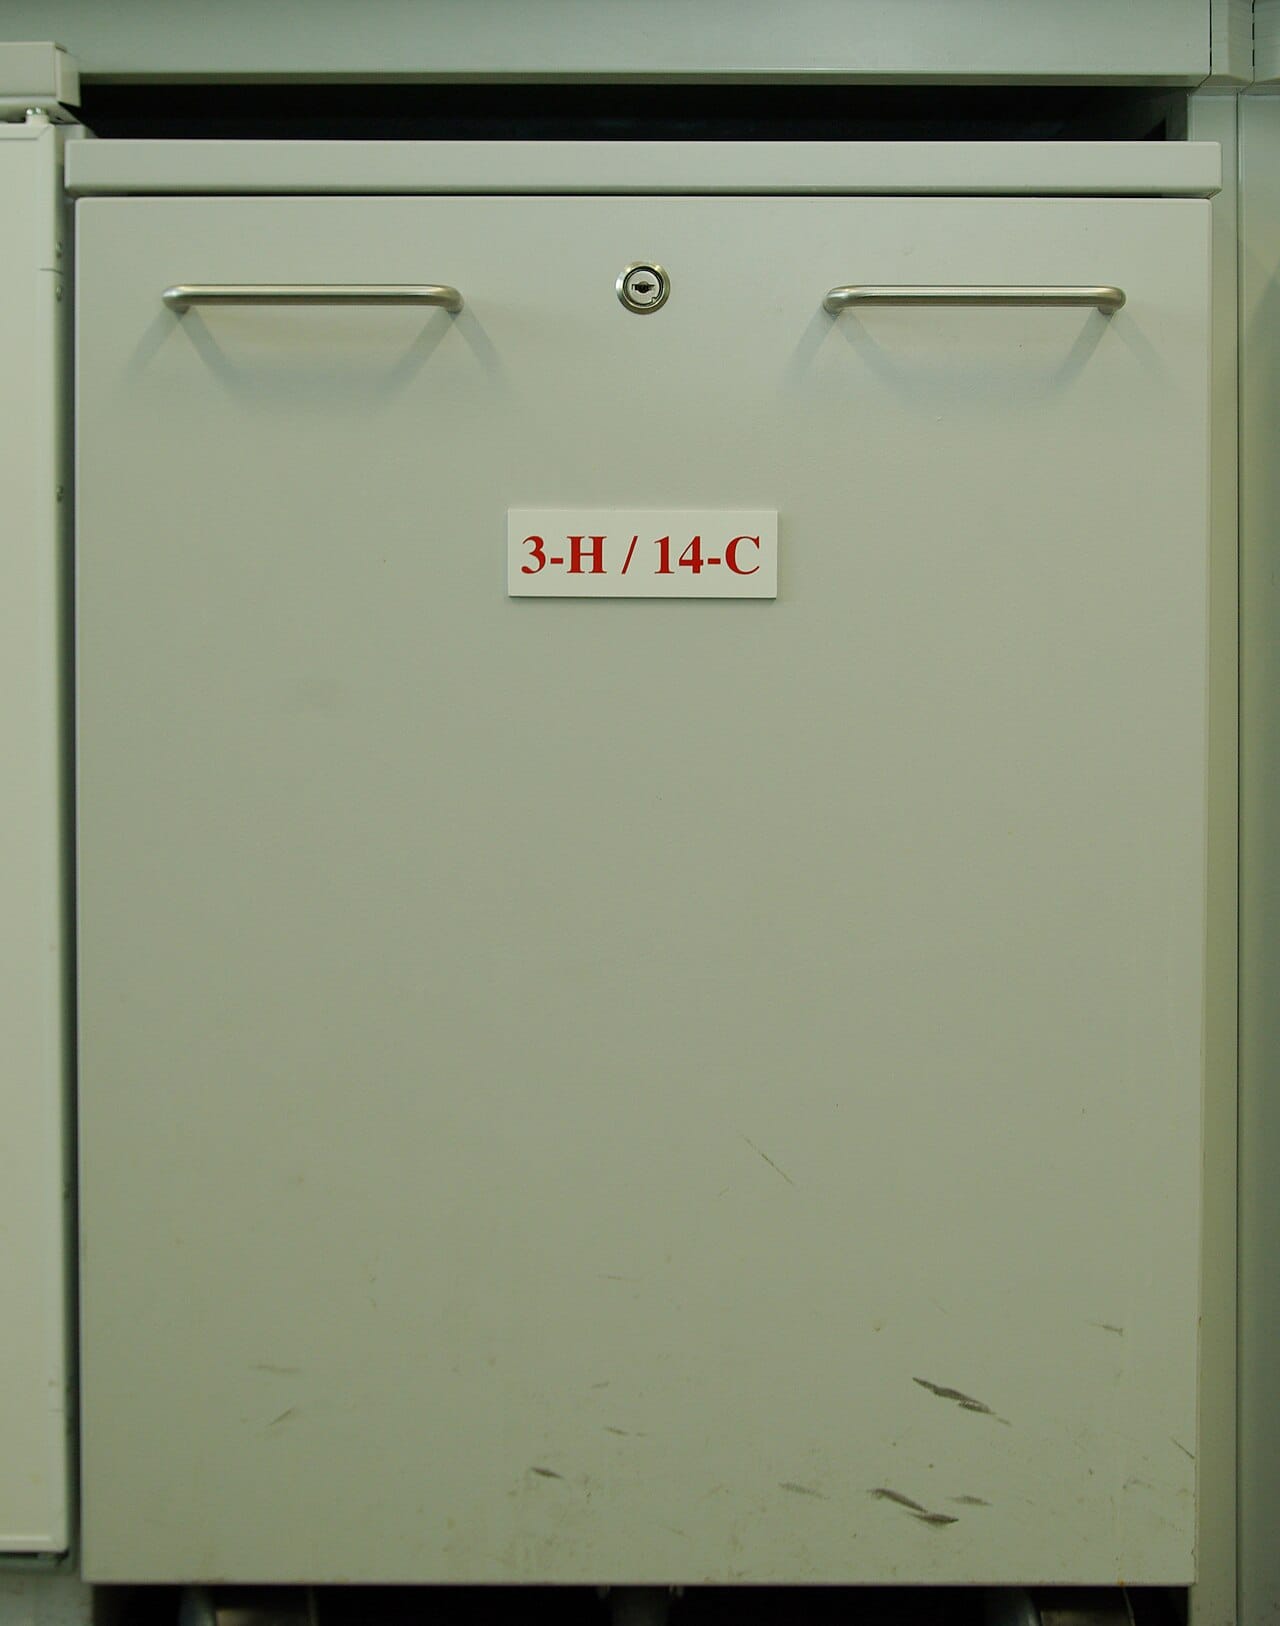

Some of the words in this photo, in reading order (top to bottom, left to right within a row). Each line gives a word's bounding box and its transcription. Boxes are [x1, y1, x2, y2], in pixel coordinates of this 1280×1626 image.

[521, 535, 607, 575] 3-H
[621, 535, 638, 575] /
[654, 535, 760, 575] 14-C
